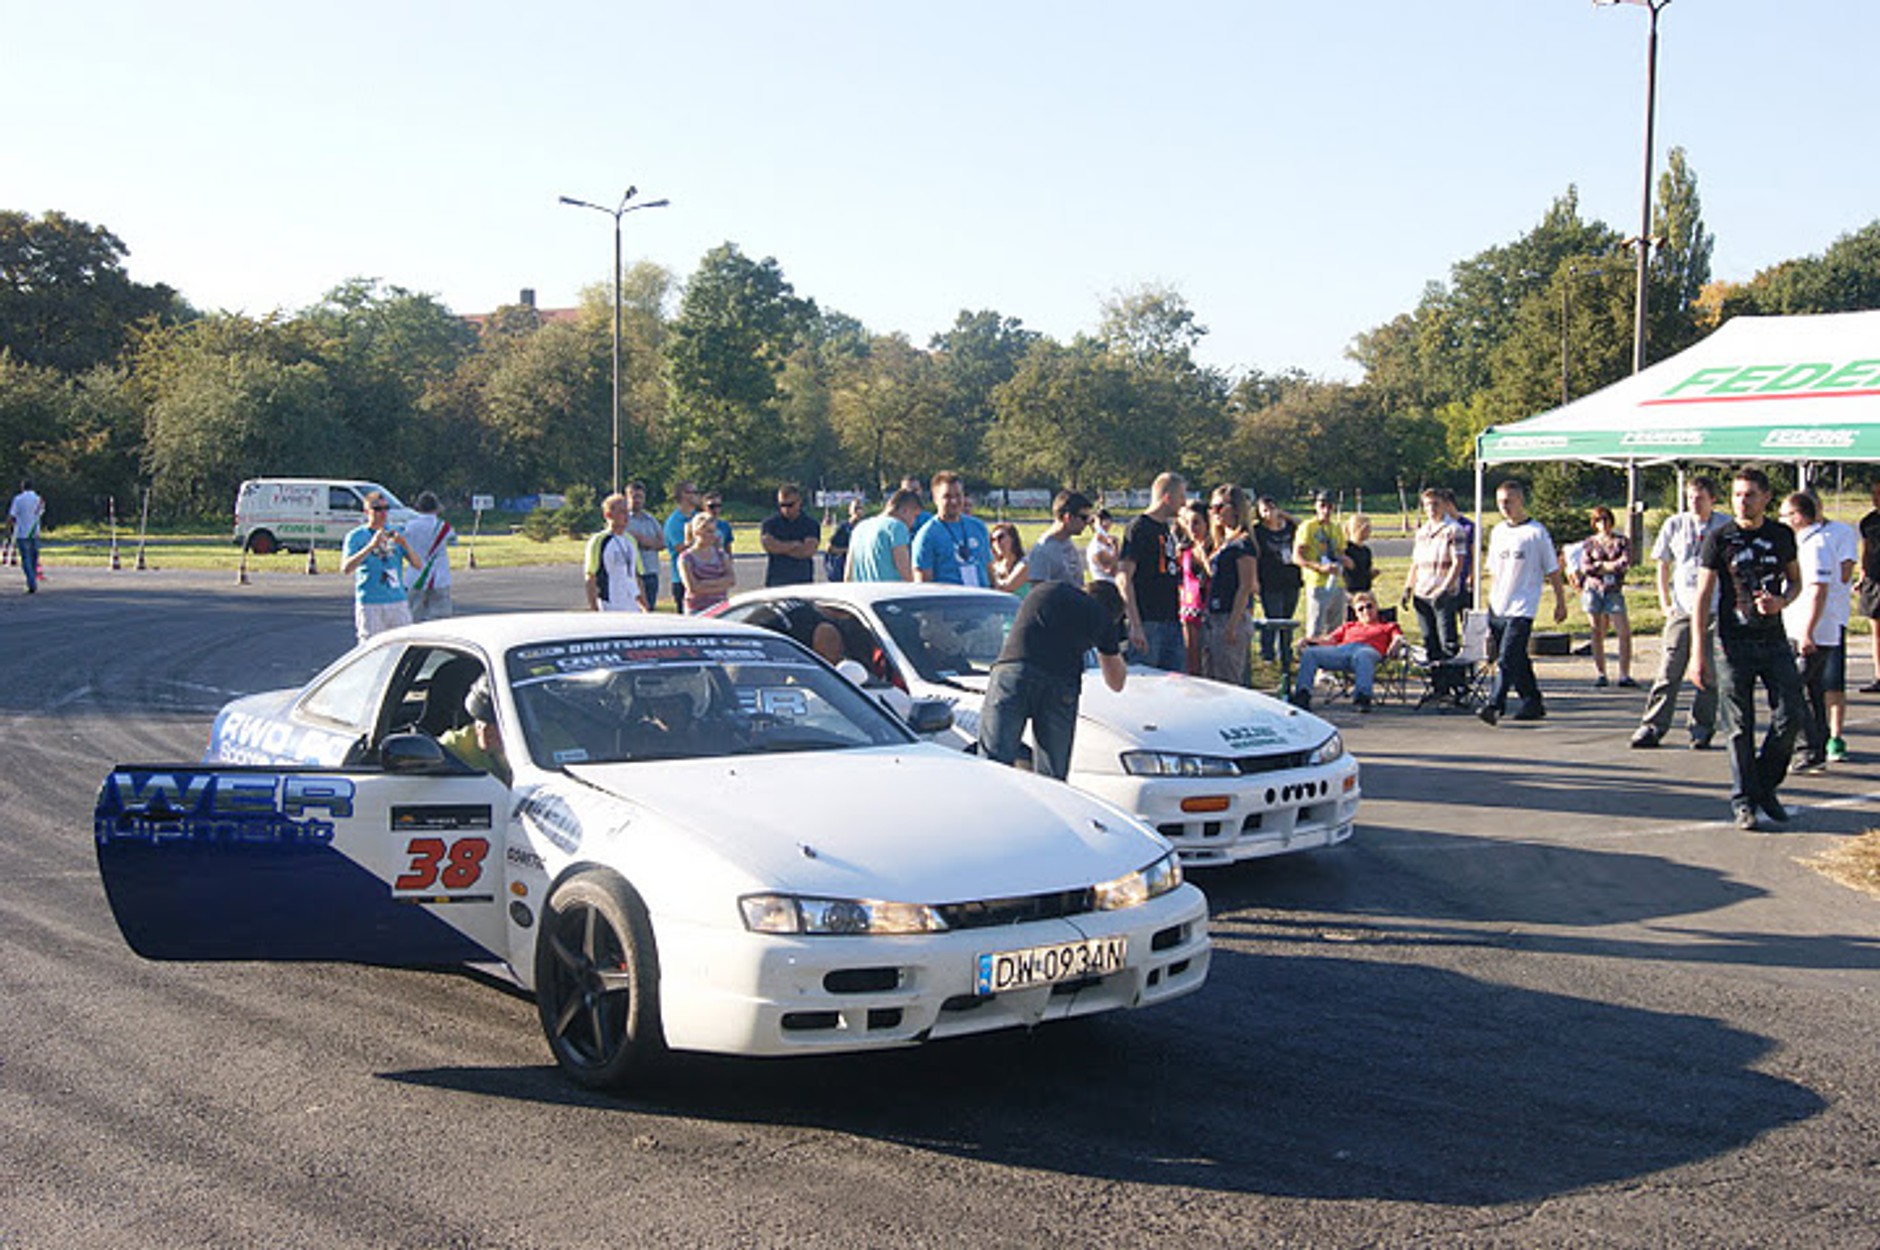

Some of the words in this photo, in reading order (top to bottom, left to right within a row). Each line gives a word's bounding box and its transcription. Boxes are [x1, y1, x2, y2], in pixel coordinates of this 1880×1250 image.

[1660, 358, 1880, 397] FEDE
[394, 838, 490, 890] 38
[997, 952, 1033, 988] DW
